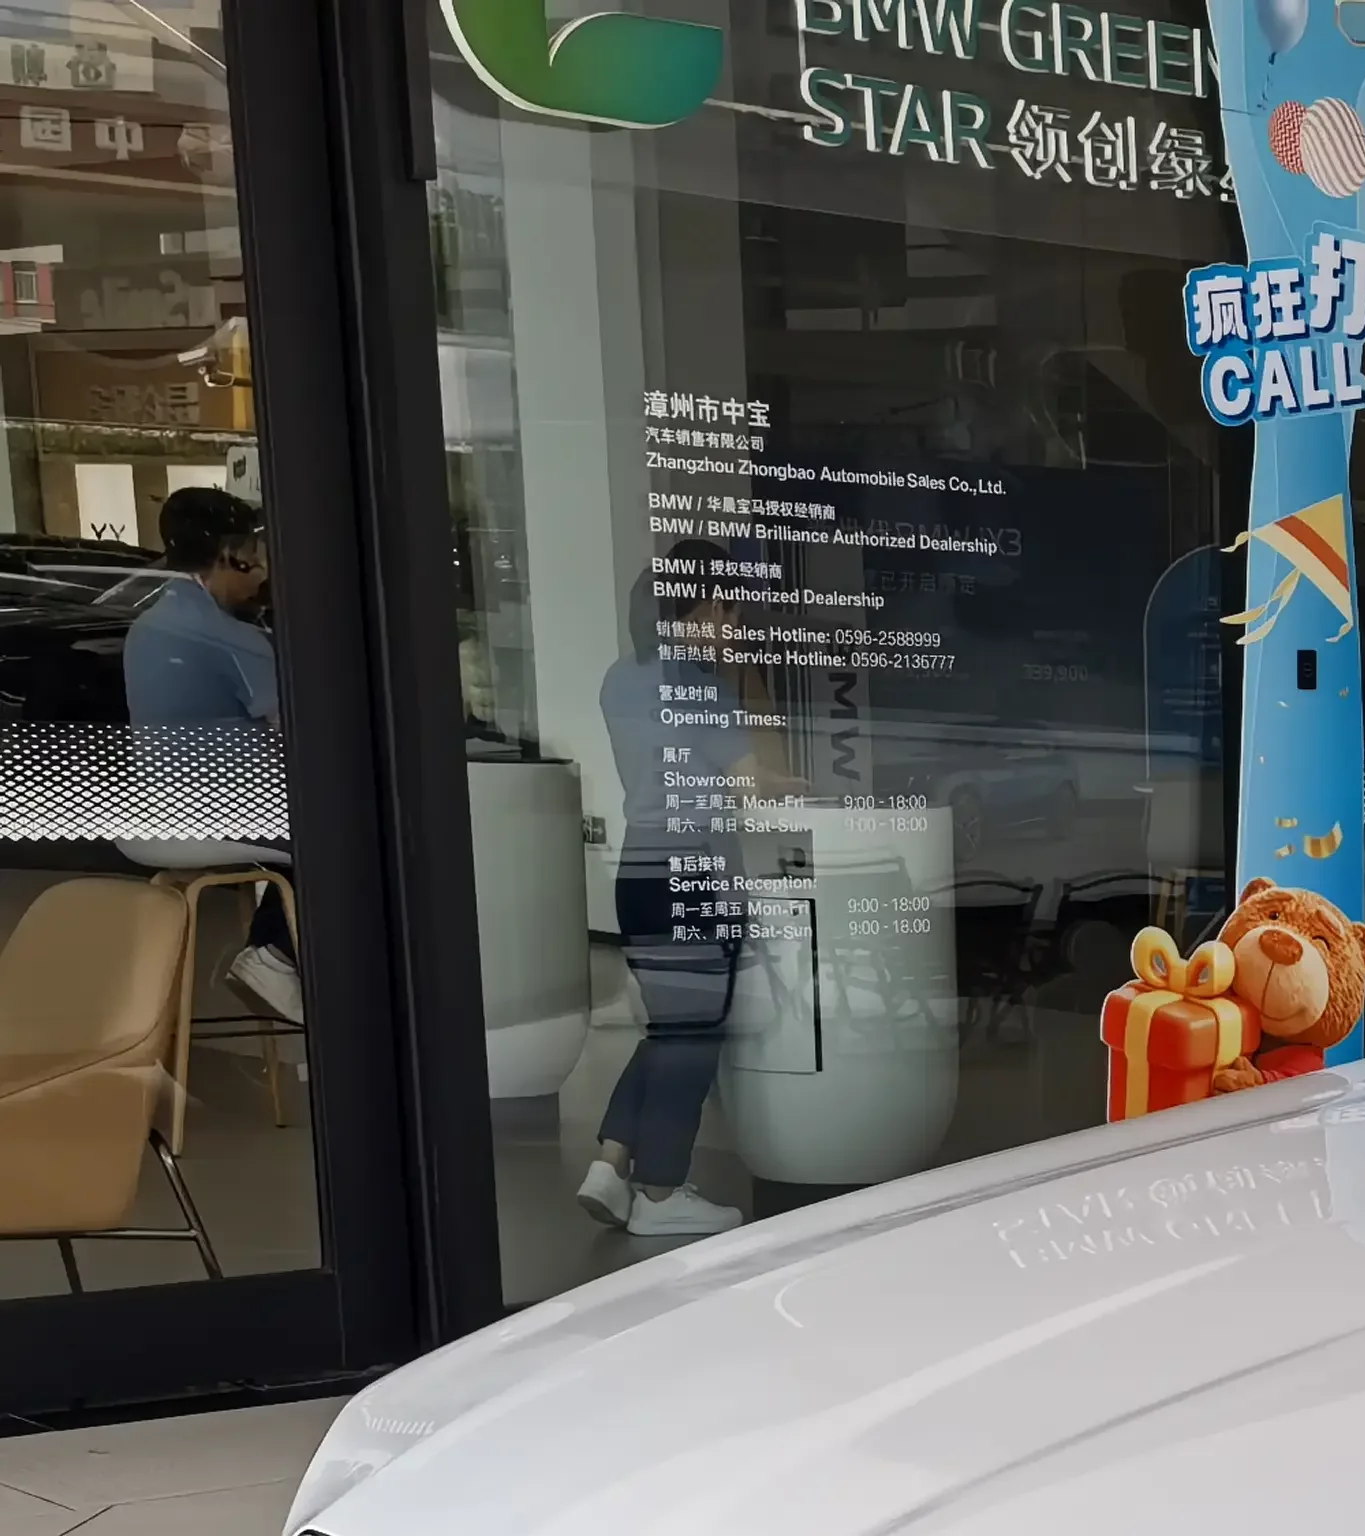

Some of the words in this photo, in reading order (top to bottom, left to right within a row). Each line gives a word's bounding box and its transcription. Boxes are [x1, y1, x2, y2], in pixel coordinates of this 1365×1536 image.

[1005, 98, 1237, 202] 领创绿
[1210, 342, 1362, 416] CALL
[644, 390, 771, 428] 漳州市中宝
[645, 426, 764, 452] 汽车销售有限公司
[646, 452, 734, 474] Zhangzhou
[738, 459, 816, 481] Zhongbao
[820, 467, 904, 488] Automobile
[908, 472, 945, 490] Sales
[648, 492, 693, 511] BMW
[707, 496, 836, 521] 华晨宝马授权经销商
[649, 516, 693, 536] BMW
[707, 520, 751, 539] BMW
[755, 524, 829, 544] Brilliance
[833, 528, 915, 549] Authorized
[920, 534, 998, 557] Dealership
[652, 557, 696, 575] BMW
[710, 559, 783, 580] 授权经销商
[653, 581, 697, 599] BMW
[712, 584, 799, 604] Authorized
[803, 588, 884, 610] Dealership
[656, 620, 716, 639] 销售热线
[721, 623, 766, 641] Sales
[769, 625, 831, 644] Hotline:
[835, 628, 941, 648] 0596-2588999
[658, 643, 717, 662] 售后热线
[722, 647, 781, 665] Service
[786, 649, 847, 667] Hotline:
[851, 651, 955, 671] 0596-2136777
[659, 685, 717, 702] 营业时间
[660, 708, 729, 728] Opening
[733, 710, 788, 727] Times:
[663, 747, 691, 763] 展厅
[664, 771, 756, 788] Showroom:
[665, 794, 738, 810] 周一至周五
[743, 795, 805, 810] Mon-Fri
[666, 817, 738, 833] 周六、周日
[668, 856, 726, 873] 售后接待
[669, 877, 730, 892] Service
[733, 876, 817, 893] Reception:
[672, 901, 743, 918] 周一至周五
[748, 900, 811, 917] Mon-Fri
[672, 924, 743, 942] 周六、周日
[749, 923, 814, 940] Sat-Sun
